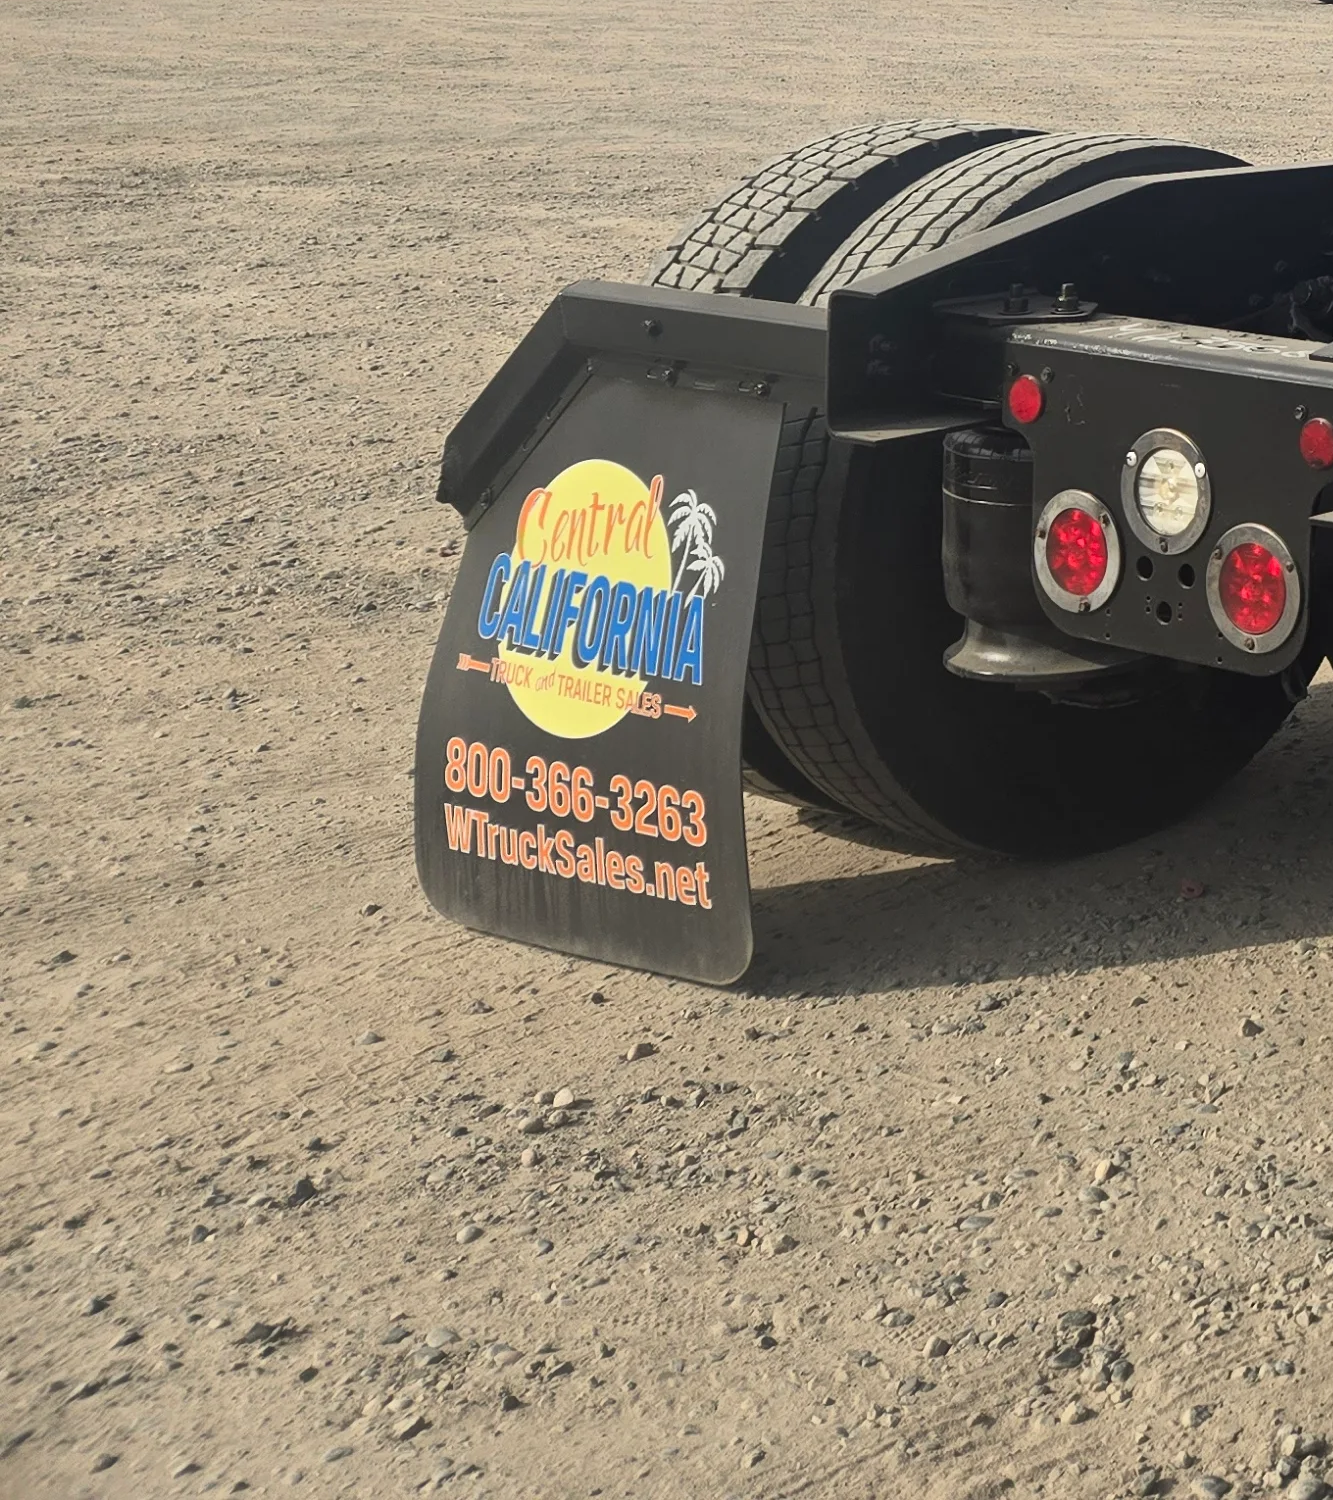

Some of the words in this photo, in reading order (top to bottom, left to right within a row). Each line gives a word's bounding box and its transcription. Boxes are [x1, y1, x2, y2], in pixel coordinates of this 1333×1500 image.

[516, 473, 665, 569] Central
[477, 553, 703, 686] CALIFORNIA
[490, 656, 534, 692] TRUCK
[534, 669, 556, 694] and
[556, 675, 613, 708] TRAILER
[615, 687, 663, 720] SALES
[445, 736, 708, 848] 800-366-3263
[444, 803, 712, 910] WTruckSales.net
